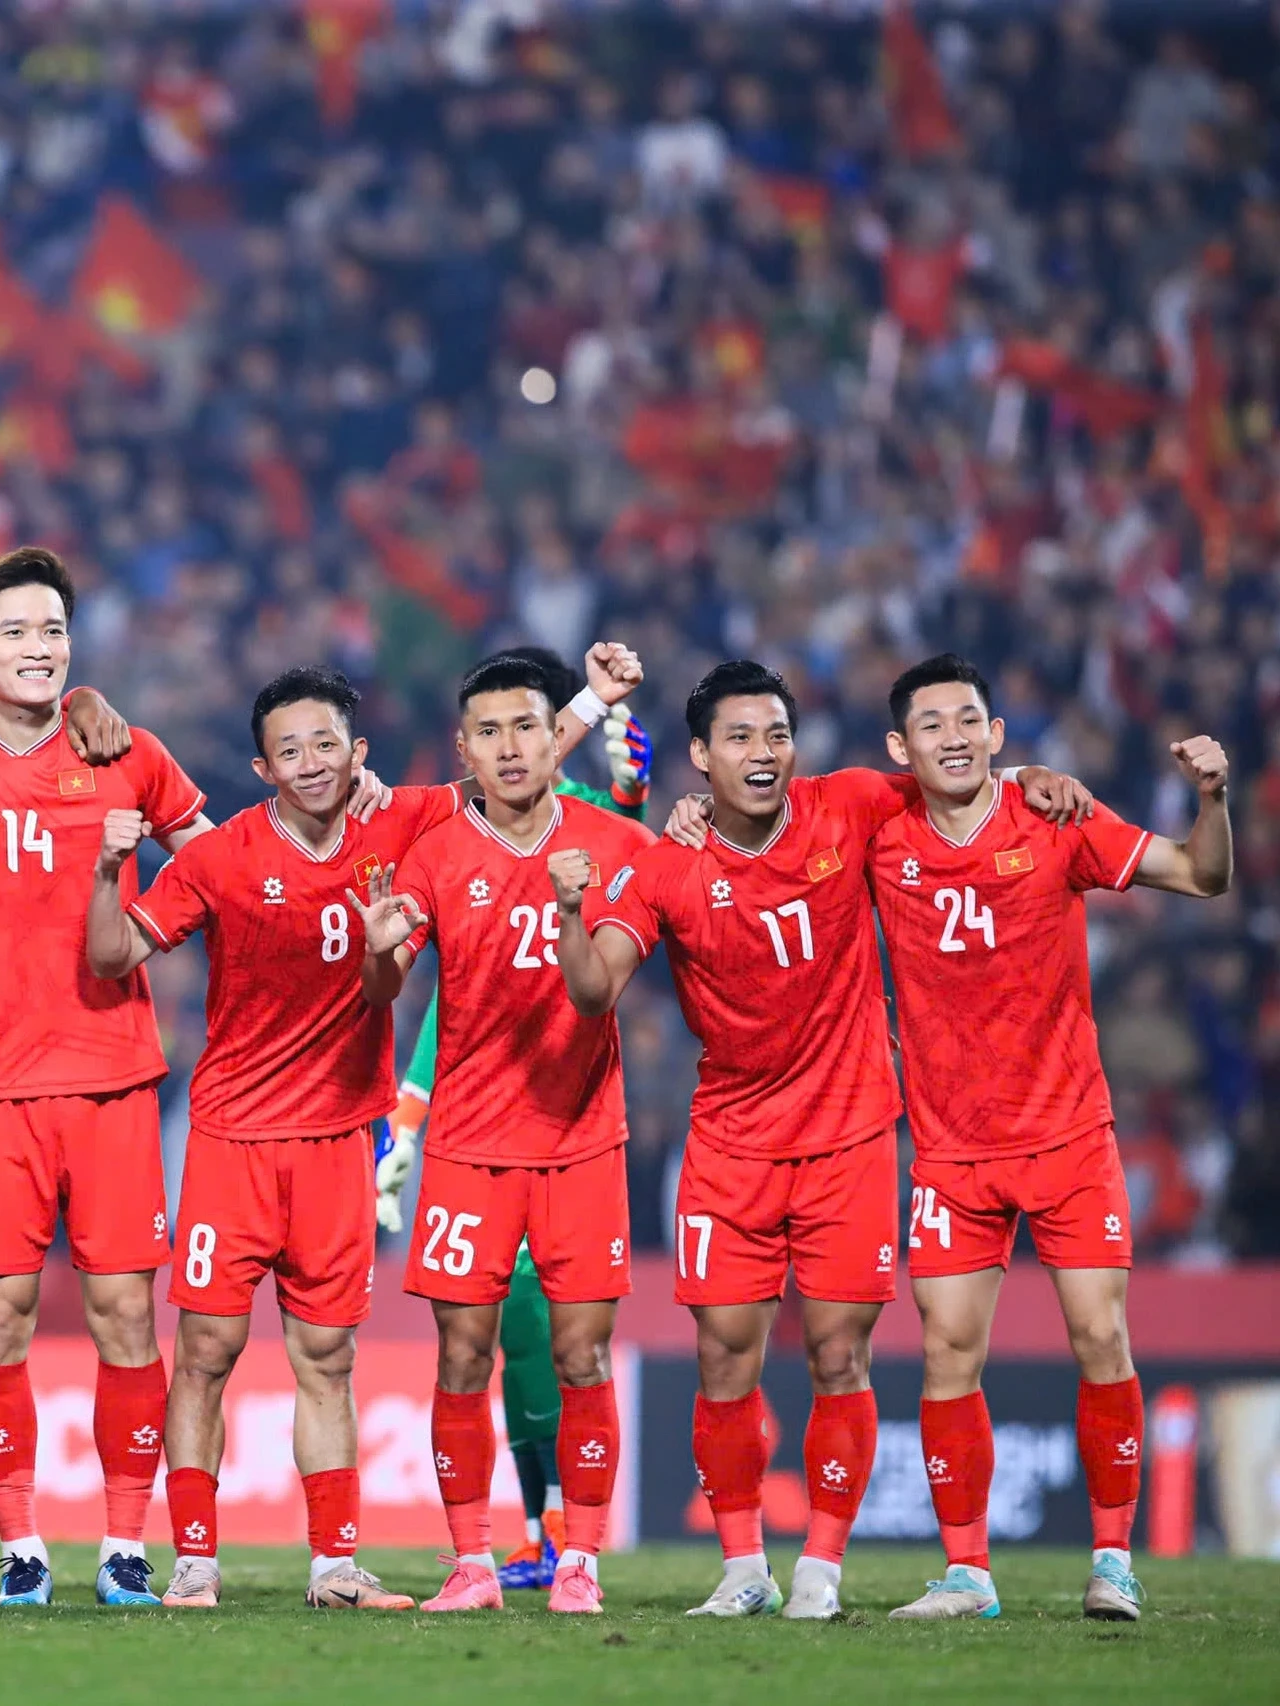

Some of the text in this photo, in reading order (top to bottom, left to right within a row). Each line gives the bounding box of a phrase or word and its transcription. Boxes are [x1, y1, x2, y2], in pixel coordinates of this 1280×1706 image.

[1, 809, 53, 873] 14
[320, 903, 349, 962] 8
[758, 899, 814, 968] 17
[934, 886, 996, 952] 24
[422, 1205, 482, 1277] 25
[678, 1214, 713, 1280] 17
[908, 1186, 951, 1249] 24
[185, 1222, 217, 1288] 8
